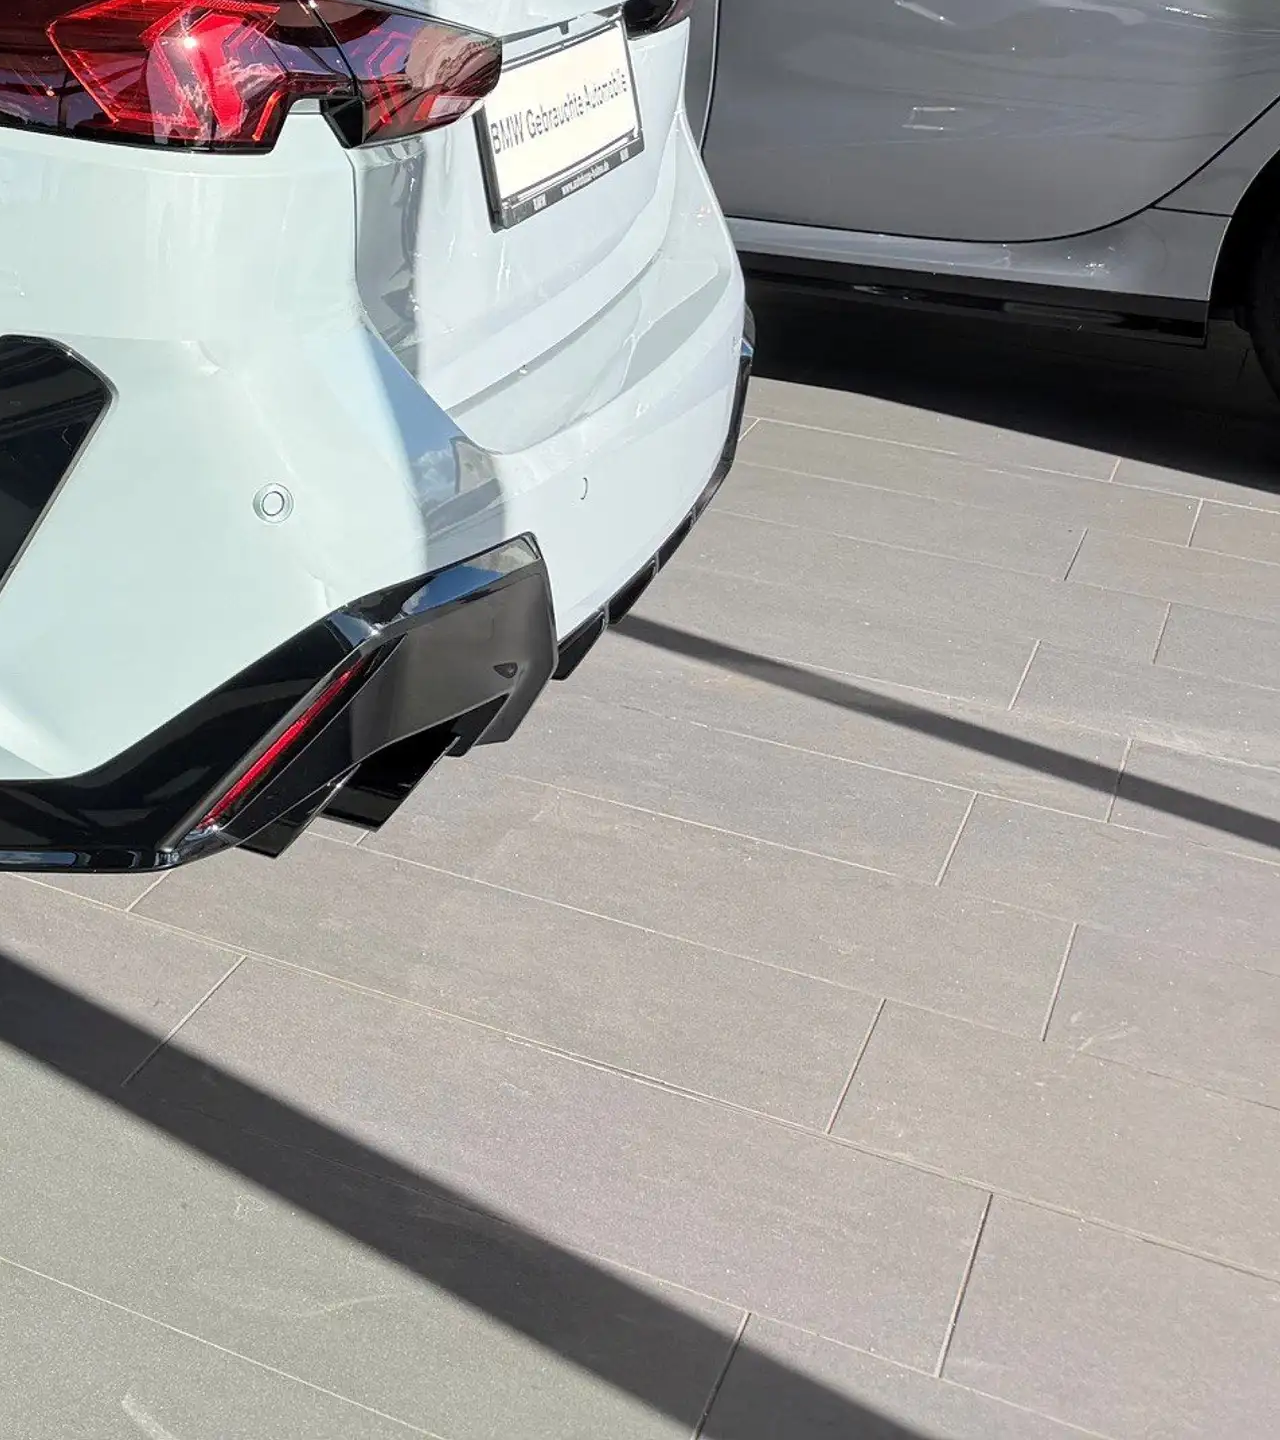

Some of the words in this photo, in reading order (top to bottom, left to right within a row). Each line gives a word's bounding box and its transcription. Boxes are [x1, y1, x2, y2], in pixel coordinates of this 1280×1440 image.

[490, 111, 524, 154] BMW
[526, 93, 584, 139] Gebrauchte
[584, 68, 627, 109] Automobile
